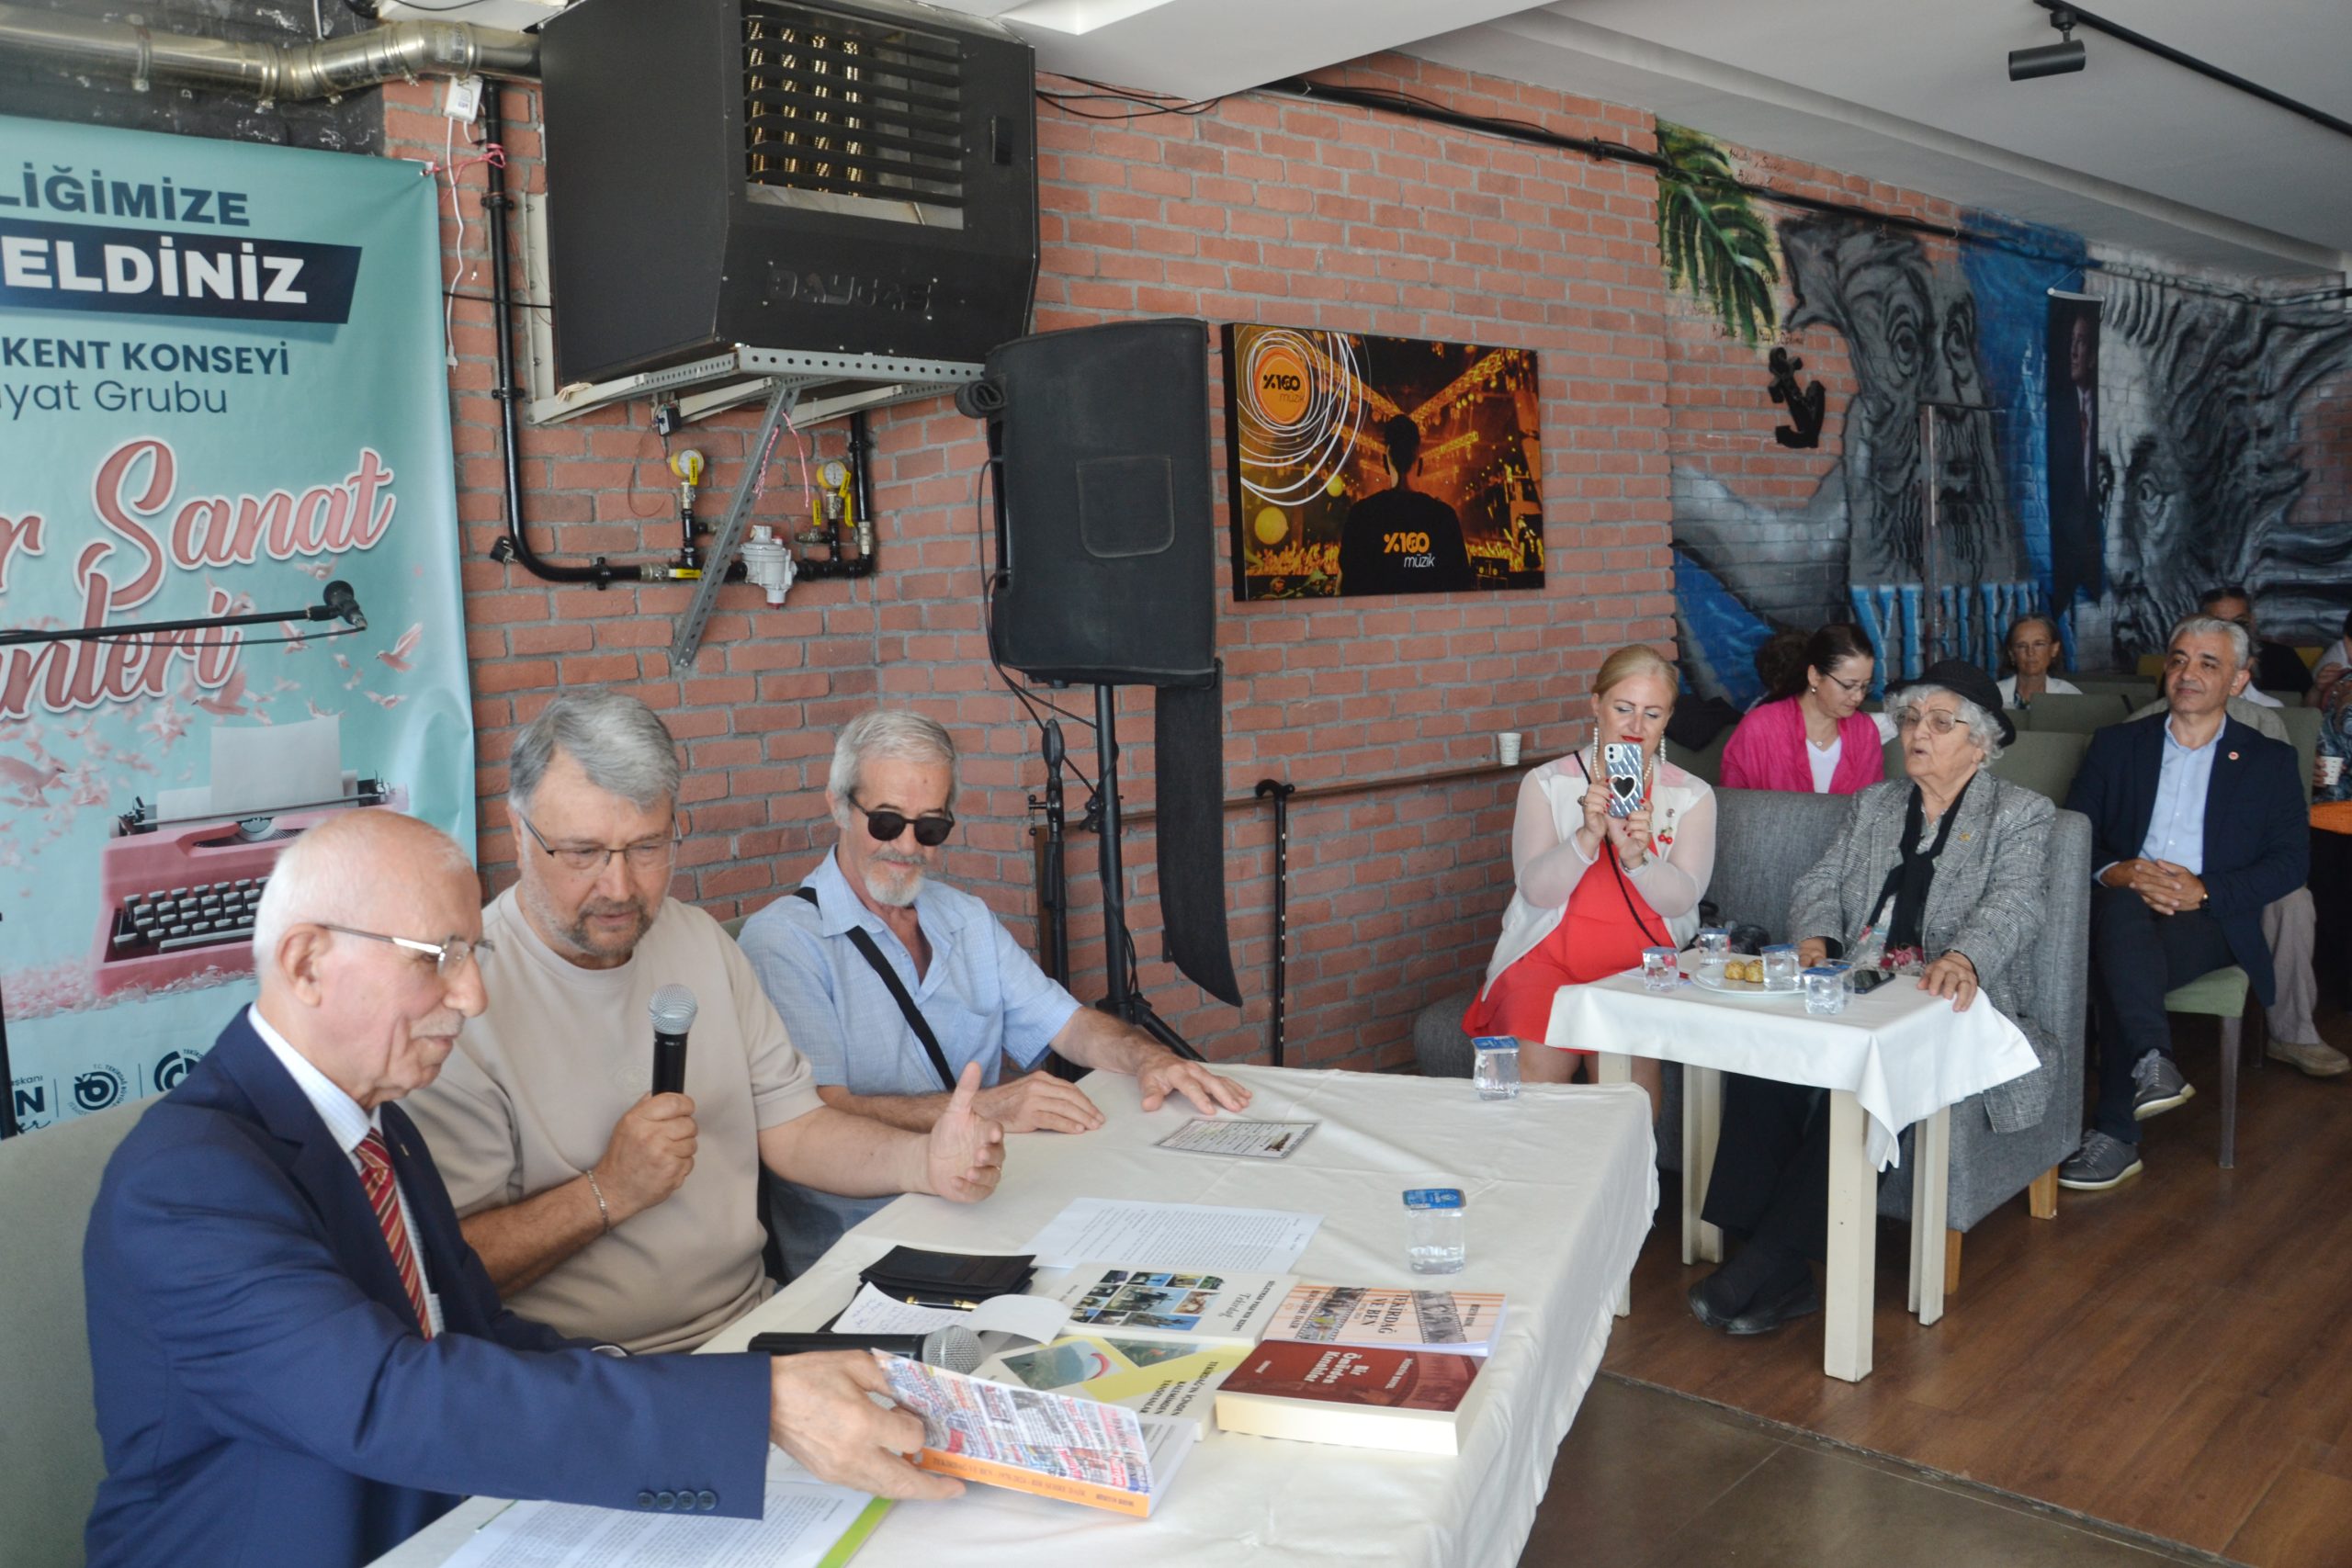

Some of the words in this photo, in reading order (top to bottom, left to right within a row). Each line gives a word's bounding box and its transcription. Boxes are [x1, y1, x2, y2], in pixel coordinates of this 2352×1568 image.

[2, 336, 110, 369] KENT
[123, 341, 289, 376] KONSEYİ
[0, 379, 81, 421] yat
[95, 380, 228, 413] Grubu
[74, 435, 397, 611] Sanat
[1404, 553, 1435, 568] müzik
[0, 568, 244, 722] nleri
[1361, 1308, 1380, 1325] BEN
[1371, 1297, 1385, 1308] VE
[1378, 1294, 1411, 1334] TEKİRDAĞ
[1323, 1352, 1362, 1384] Ömürden
[1350, 1364, 1370, 1376] Bir
